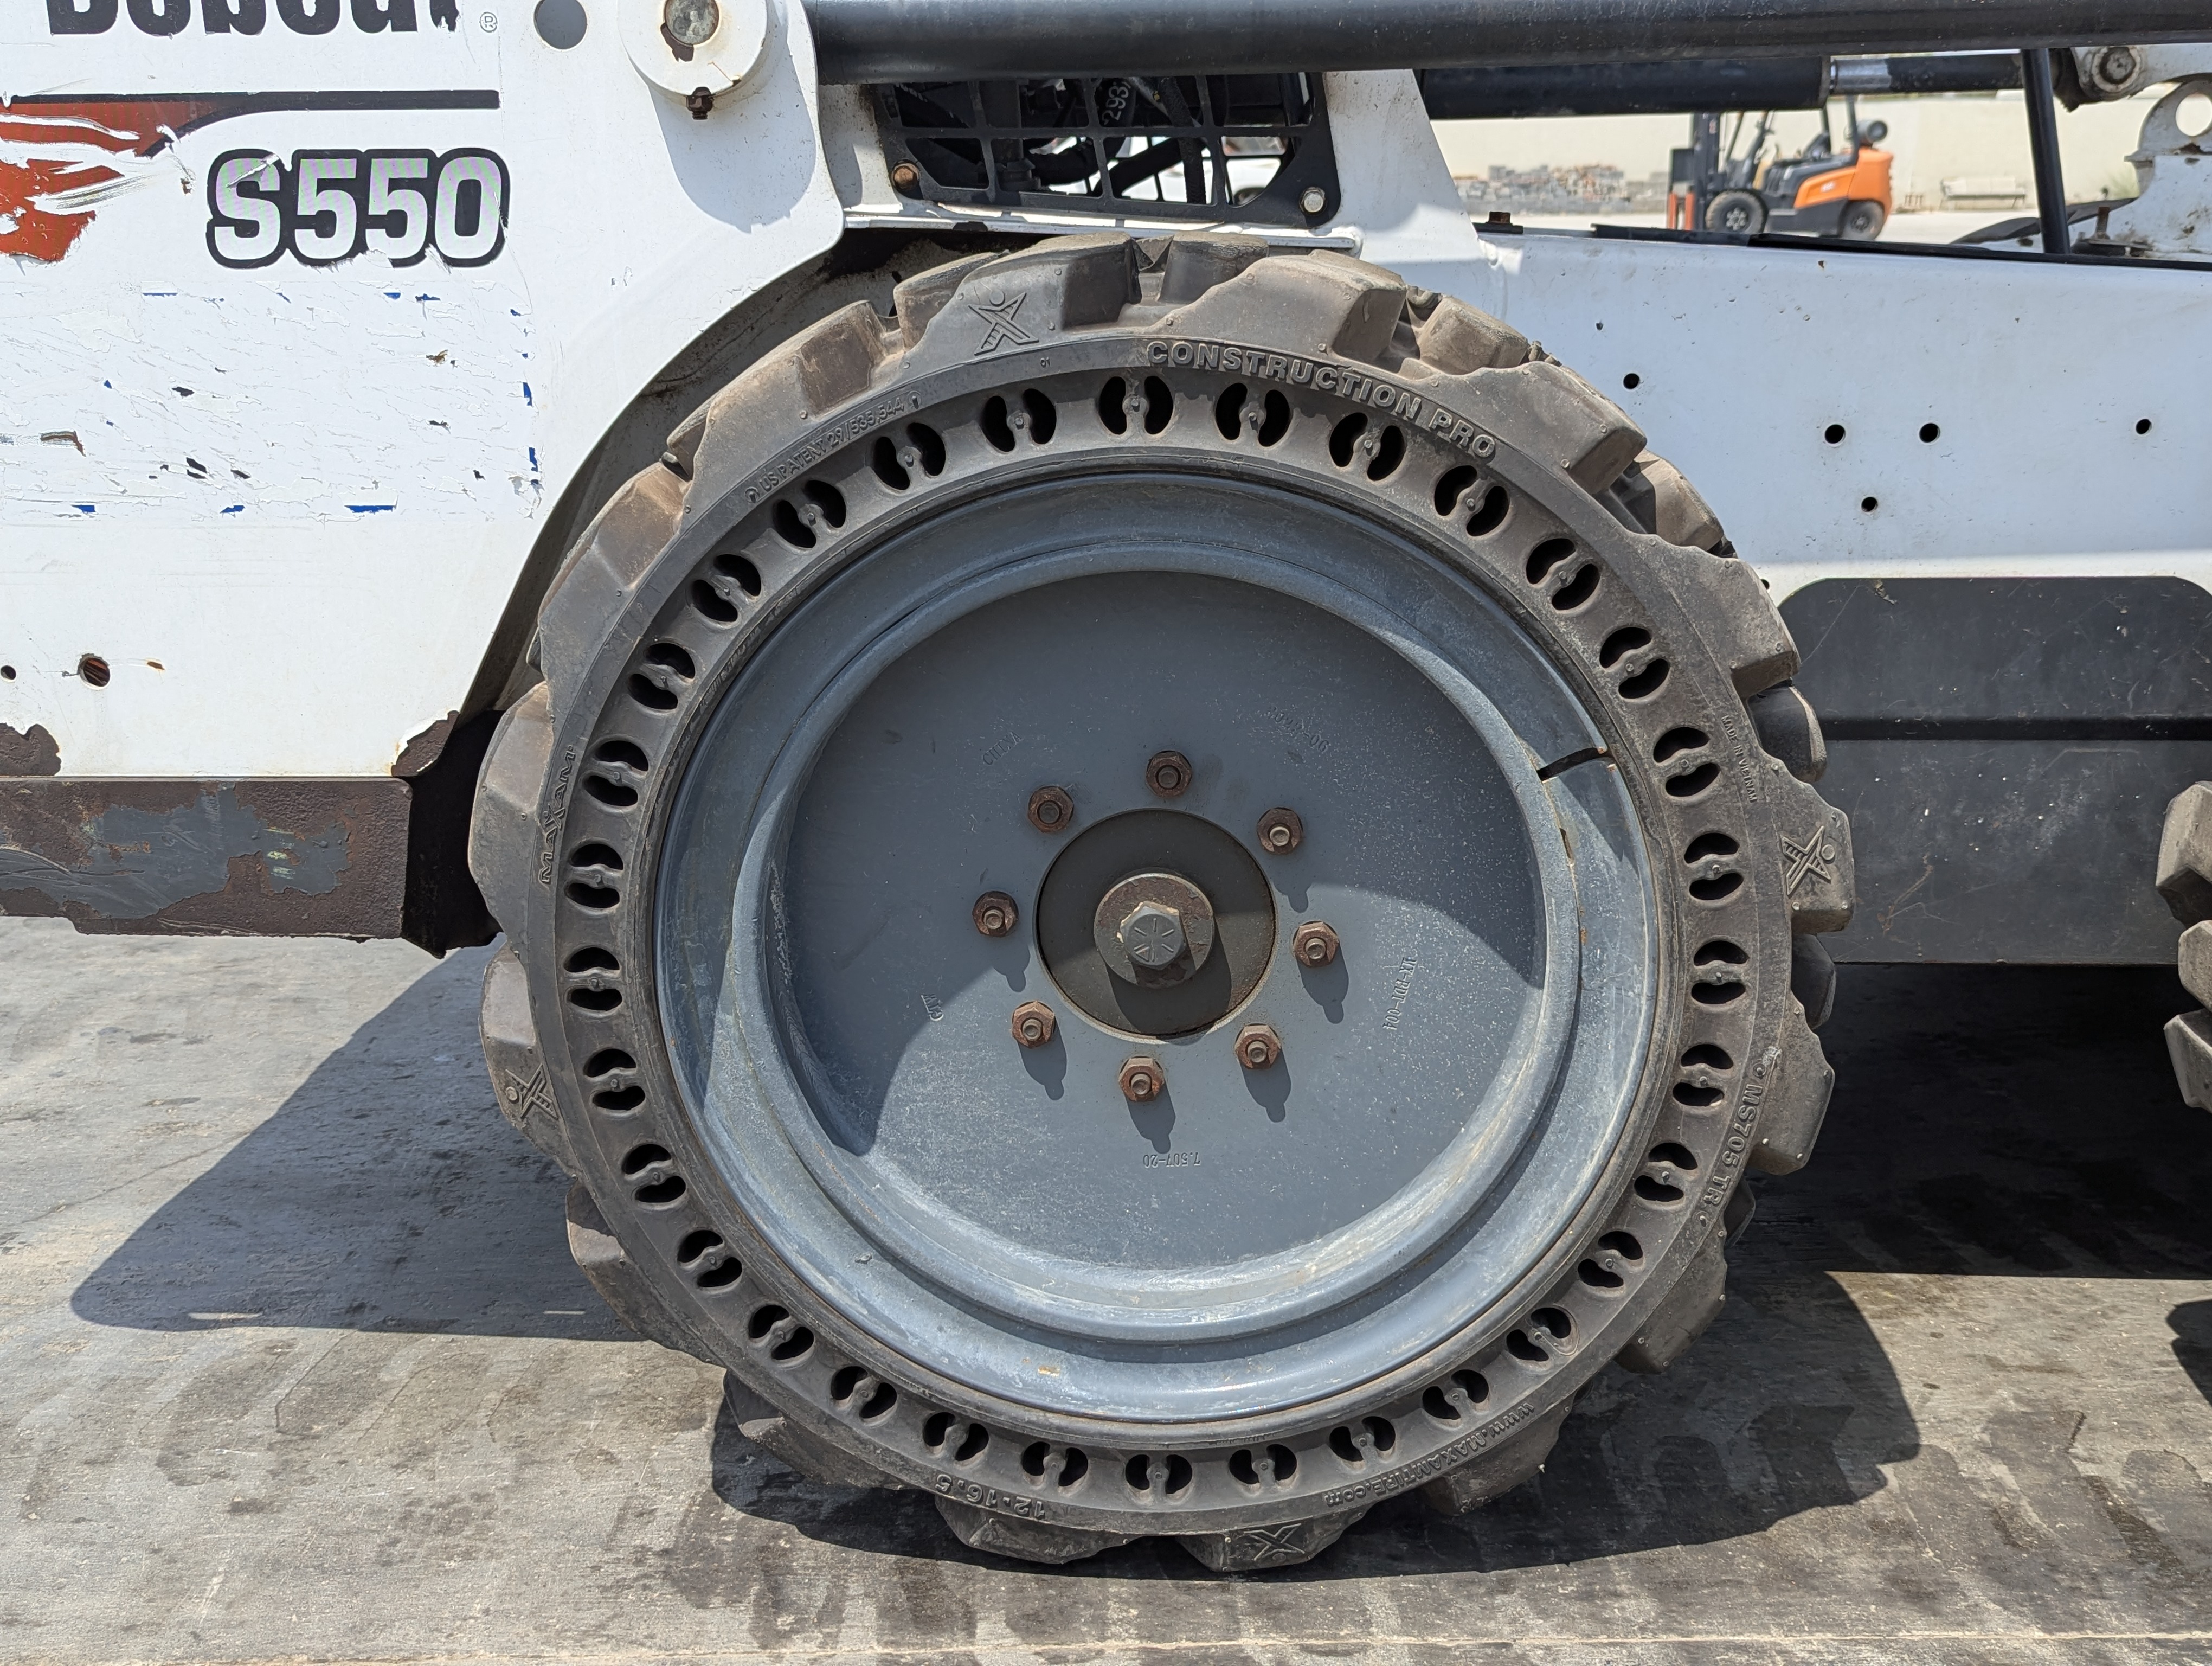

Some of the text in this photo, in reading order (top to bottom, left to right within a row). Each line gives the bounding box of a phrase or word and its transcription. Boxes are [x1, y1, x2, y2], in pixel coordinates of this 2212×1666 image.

[206, 148, 511, 269] S550
[1146, 339, 1497, 460] CONSTRUCTION PRO
[759, 471, 779, 492] US
[779, 438, 827, 475] PATENT
[537, 749, 576, 885] MAXAM
[1720, 714, 1758, 804] MADE IN VIETNAM
[1703, 1083, 1763, 1206] MS705 TR
